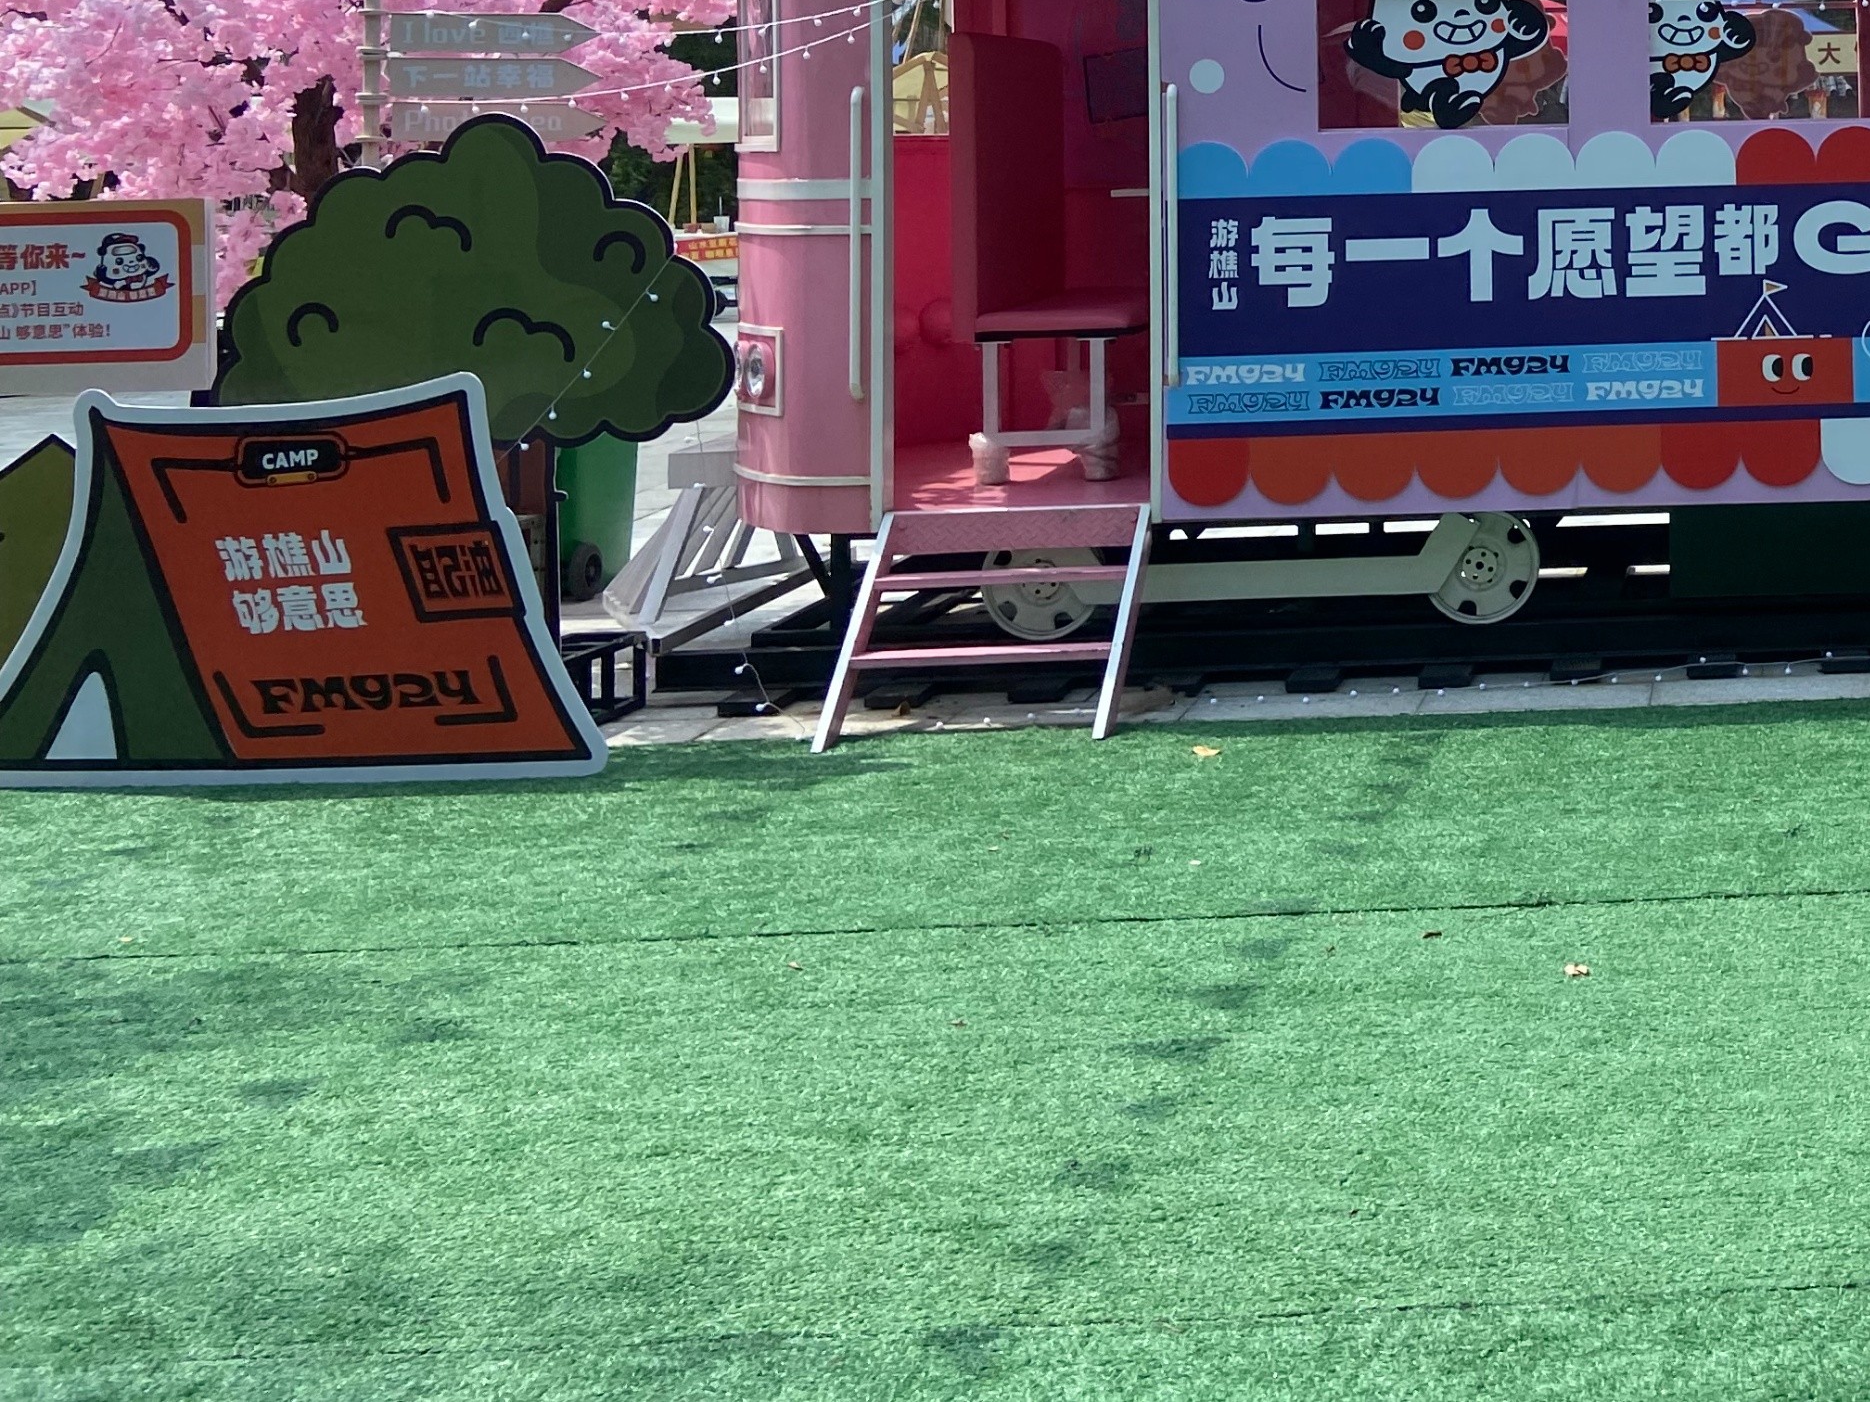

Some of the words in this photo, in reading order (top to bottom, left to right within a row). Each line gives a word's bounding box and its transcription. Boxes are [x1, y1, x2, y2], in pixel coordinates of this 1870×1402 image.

[423, 21, 487, 45] love
[402, 63, 555, 89] 下一站幸福
[1208, 218, 1239, 311] 游樵山
[1186, 363, 1306, 386] FM924
[1318, 358, 1442, 382] FM924
[1450, 354, 1571, 377] FM924
[1188, 390, 1311, 414] FM924
[1319, 387, 1442, 410] FM924
[1585, 378, 1705, 401] FM924
[261, 449, 319, 470] CAMP
[215, 529, 352, 582] 游樵山
[232, 582, 369, 635] 够意思
[250, 670, 485, 715] FM924
